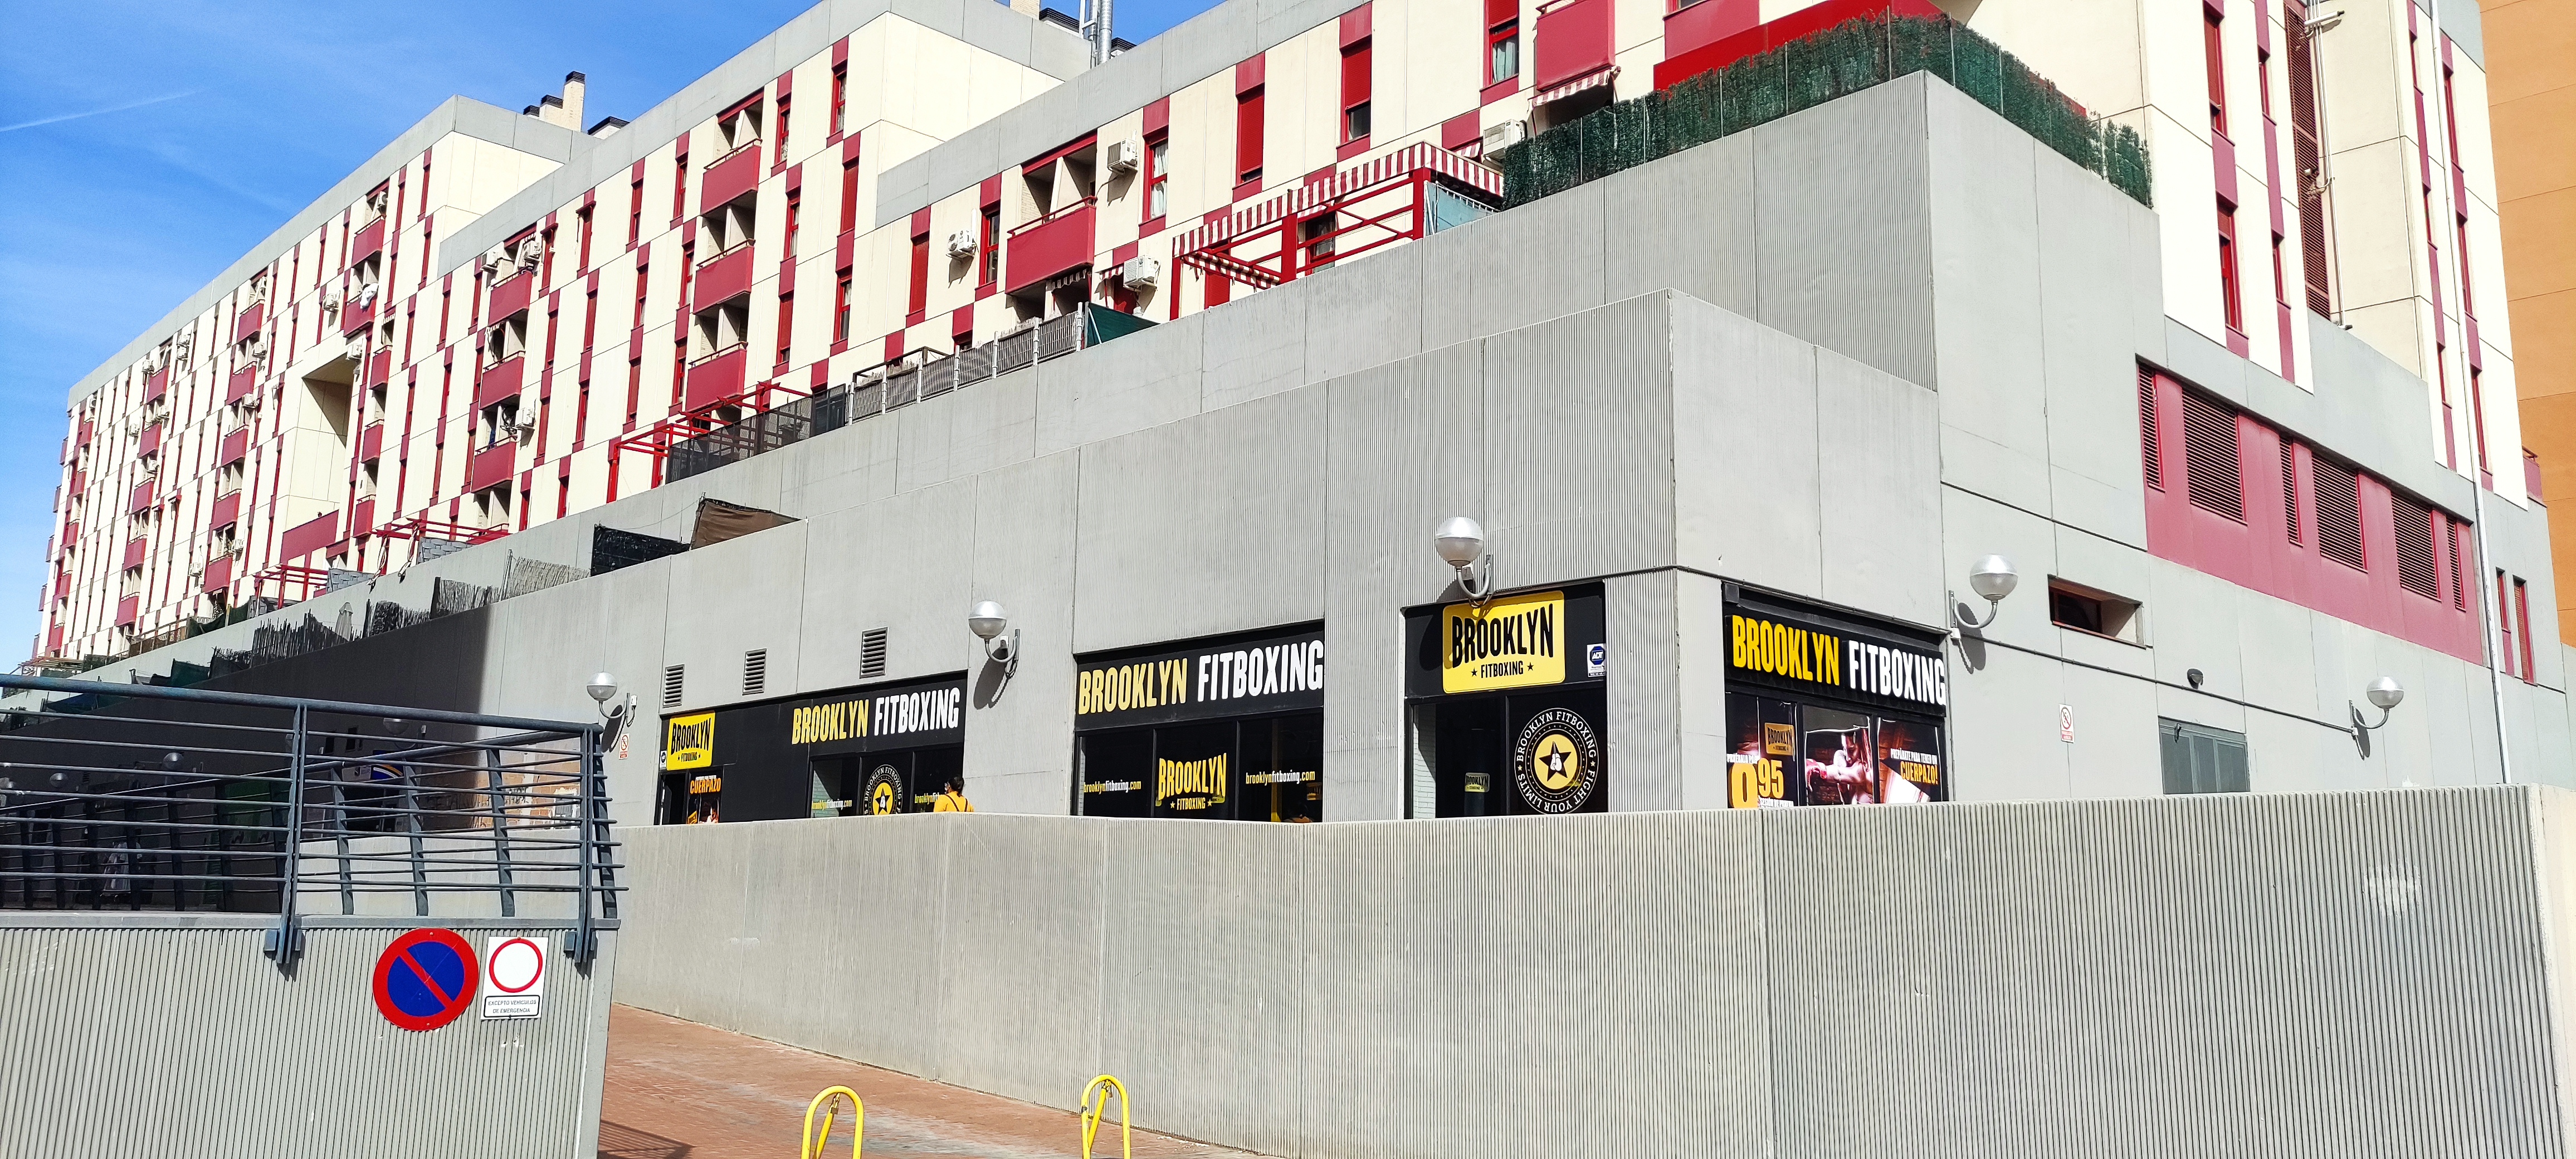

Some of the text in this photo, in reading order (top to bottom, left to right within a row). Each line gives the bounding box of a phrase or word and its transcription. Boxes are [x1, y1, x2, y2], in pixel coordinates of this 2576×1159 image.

[1452, 603, 1554, 668] BROOKLYN
[1592, 651, 1603, 660] ADT
[1731, 615, 1946, 706] BROOKLYN FITBOXING
[1078, 639, 1324, 715] BROOKLYN FITBOXING
[1481, 661, 1524, 679] FITBOXING
[791, 687, 960, 745] BROOKLYN FITBOXING
[671, 718, 711, 756] BROOKLYN
[1516, 712, 1553, 762] BROOKLYN
[1555, 711, 1597, 758] FITBOXING
[1767, 727, 1793, 747] BROOKLYN
[681, 751, 697, 762] FITBOXING
[1158, 752, 1227, 801] BROOKLYN
[1246, 770, 1315, 785] brooklynfitboxing.com
[1900, 761, 1938, 785] CUERPAZO!
[690, 777, 721, 795] CUERPAZO
[1084, 780, 1141, 795] brooklynfitboxing.com
[1518, 770, 1596, 813] FIGHT YOUR LIMITS
[1177, 797, 1206, 811] FITBOXING
